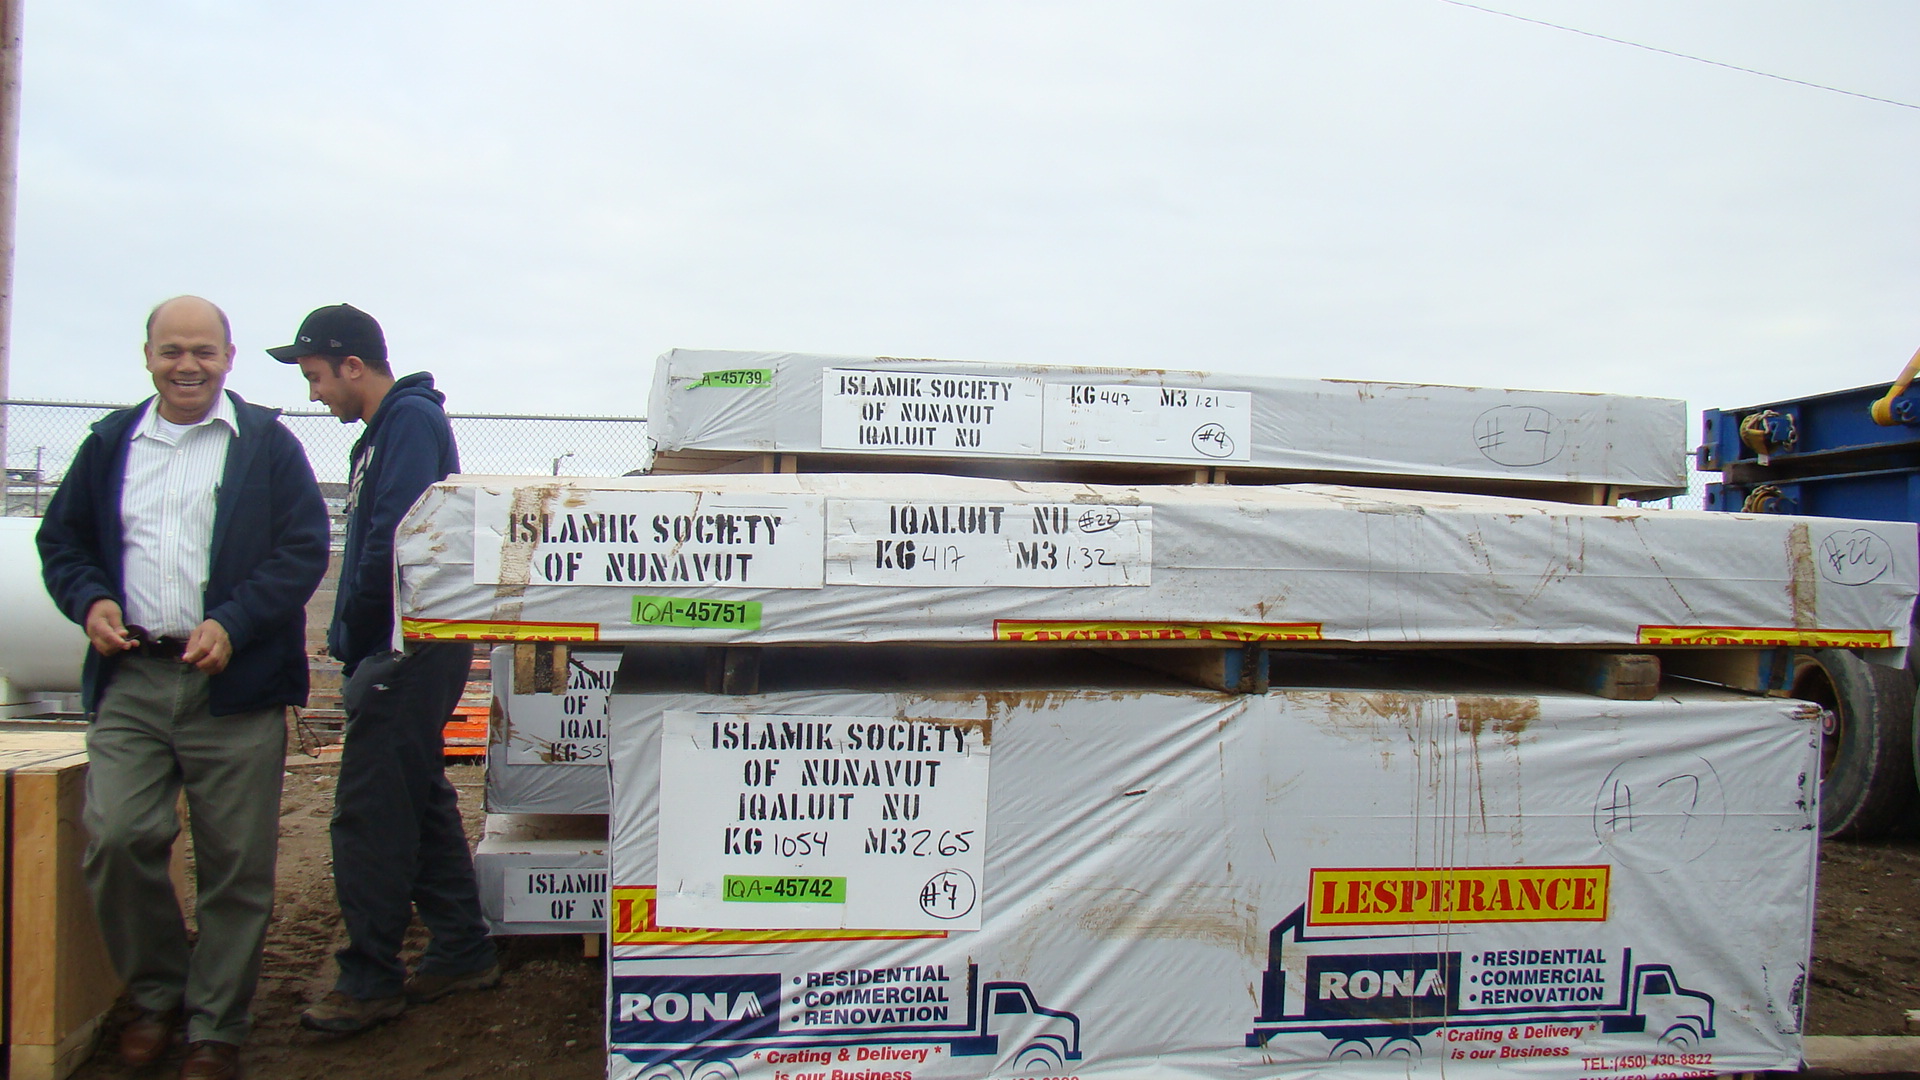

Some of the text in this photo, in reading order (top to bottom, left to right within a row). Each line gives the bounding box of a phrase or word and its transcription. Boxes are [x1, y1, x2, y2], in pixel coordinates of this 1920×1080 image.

[840, 376, 1012, 401] ISLAMIK SOCIETY
[1071, 385, 1219, 408] KG 447 M3 1.21
[862, 403, 995, 424] OF NUNAVUT
[859, 425, 981, 447] IQALUIT NU
[1479, 412, 1551, 463] #4
[510, 514, 782, 545] ISLAMIK SOCIETY
[890, 505, 1069, 535] IQALUIT NU
[1079, 509, 1114, 529] #22
[544, 552, 753, 582] OF NUNAVUT
[876, 540, 1116, 572] KG 417 M3 1.32
[564, 695, 588, 715] OF
[560, 719, 607, 739] IQAL
[712, 722, 970, 753] ISLAMIK SOCIETY
[550, 743, 606, 761] KG 55
[744, 759, 941, 787] OF NUNAVUT
[739, 793, 920, 820] IQALUIT NU
[1602, 774, 1699, 839] #7
[724, 827, 974, 857] KG 1054 M3 2.65
[727, 878, 833, 898] IQA-45742
[921, 880, 957, 910] #7
[1319, 878, 1597, 914] LESPERANCE
[551, 899, 576, 919] OF
[1482, 949, 1606, 966] RESIDENTIAL
[806, 965, 949, 988] RESIDENTIAL
[1318, 969, 1445, 999] RONA
[1480, 969, 1605, 986] COMMERCIAL
[620, 991, 765, 1022] RONA
[804, 986, 949, 1008] COMMERCIAL
[1480, 987, 1604, 1004] RENOVATION
[804, 1006, 948, 1025] RENOVATION
[1447, 1024, 1584, 1043] Crating & Delivery
[767, 1045, 928, 1065] Crating & Delivery
[1451, 1045, 1570, 1060] is our Business
[1651, 1053, 1712, 1066] 430-8822
[774, 1069, 912, 1080] is our Business
